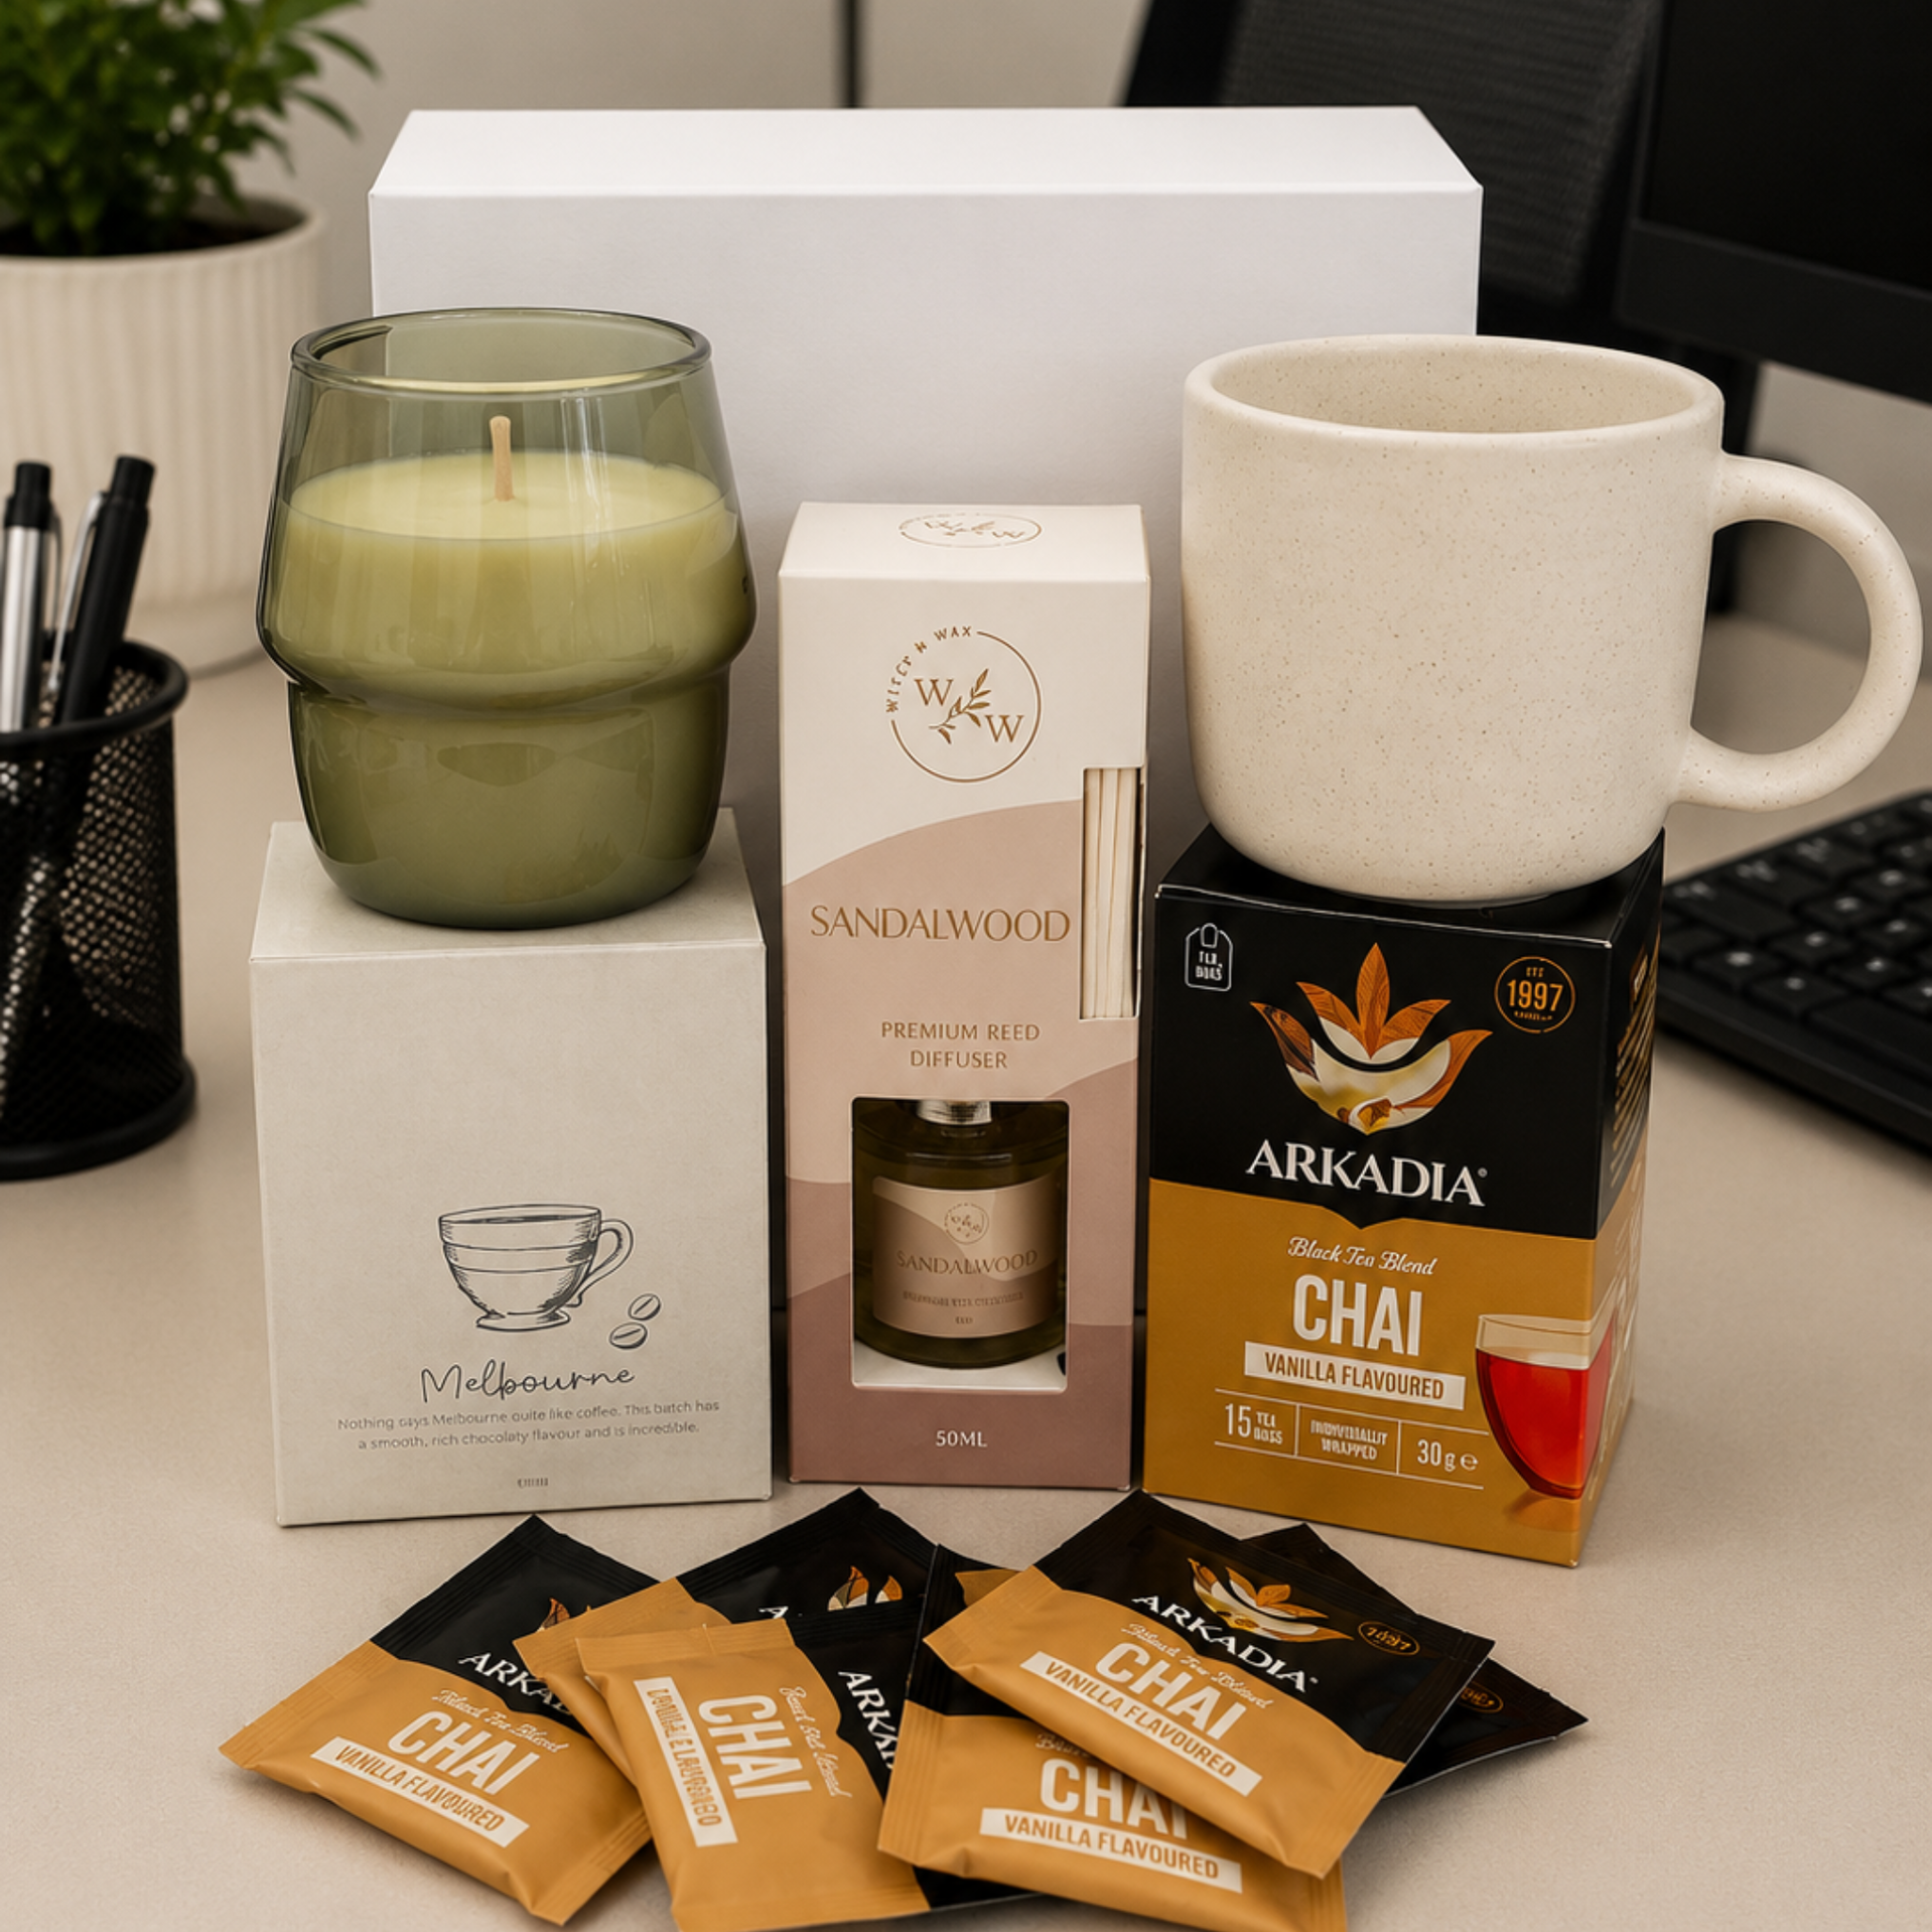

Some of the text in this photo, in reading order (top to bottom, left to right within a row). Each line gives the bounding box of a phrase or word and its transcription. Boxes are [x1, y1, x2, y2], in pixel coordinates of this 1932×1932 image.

[933, 625, 973, 641] WAX
[913, 678, 955, 707] W
[984, 715, 1025, 743] W
[810, 904, 1071, 941] SANDALWOOD
[1507, 979, 1564, 1012] 1997
[881, 1021, 1040, 1041] PREMIUM REED
[909, 1049, 1008, 1069] DIFFUSER
[896, 1249, 1038, 1275] SANDALWOOD
[1287, 1236, 1343, 1263] Black
[1378, 1250, 1439, 1275] Blend
[1293, 1274, 1423, 1356] CHAI
[420, 1359, 635, 1403] Melbourne
[1264, 1351, 1445, 1401] VANILLA FLAVOURED
[338, 1416, 395, 1432] Nothing
[432, 1411, 508, 1427] Melbourne
[695, 1400, 720, 1412] has
[1225, 1403, 1252, 1438] 15
[358, 1440, 367, 1449] a
[370, 1436, 428, 1449] smooth,
[462, 1430, 530, 1446] chocolaty
[584, 1426, 611, 1439] and
[627, 1422, 700, 1437] incredible.
[935, 1430, 988, 1448] 50ML
[1095, 1642, 1248, 1740] CHAI
[1045, 1661, 1237, 1778] VANILLA FLAVOURED
[387, 1711, 540, 1796] CHAI
[698, 1695, 813, 1799] CHAI
[335, 1745, 505, 1832] VANILLA FLAVOURED
[1039, 1758, 1187, 1840] CHAI
[1005, 1814, 1219, 1879] VANILLA FLAVOURED
